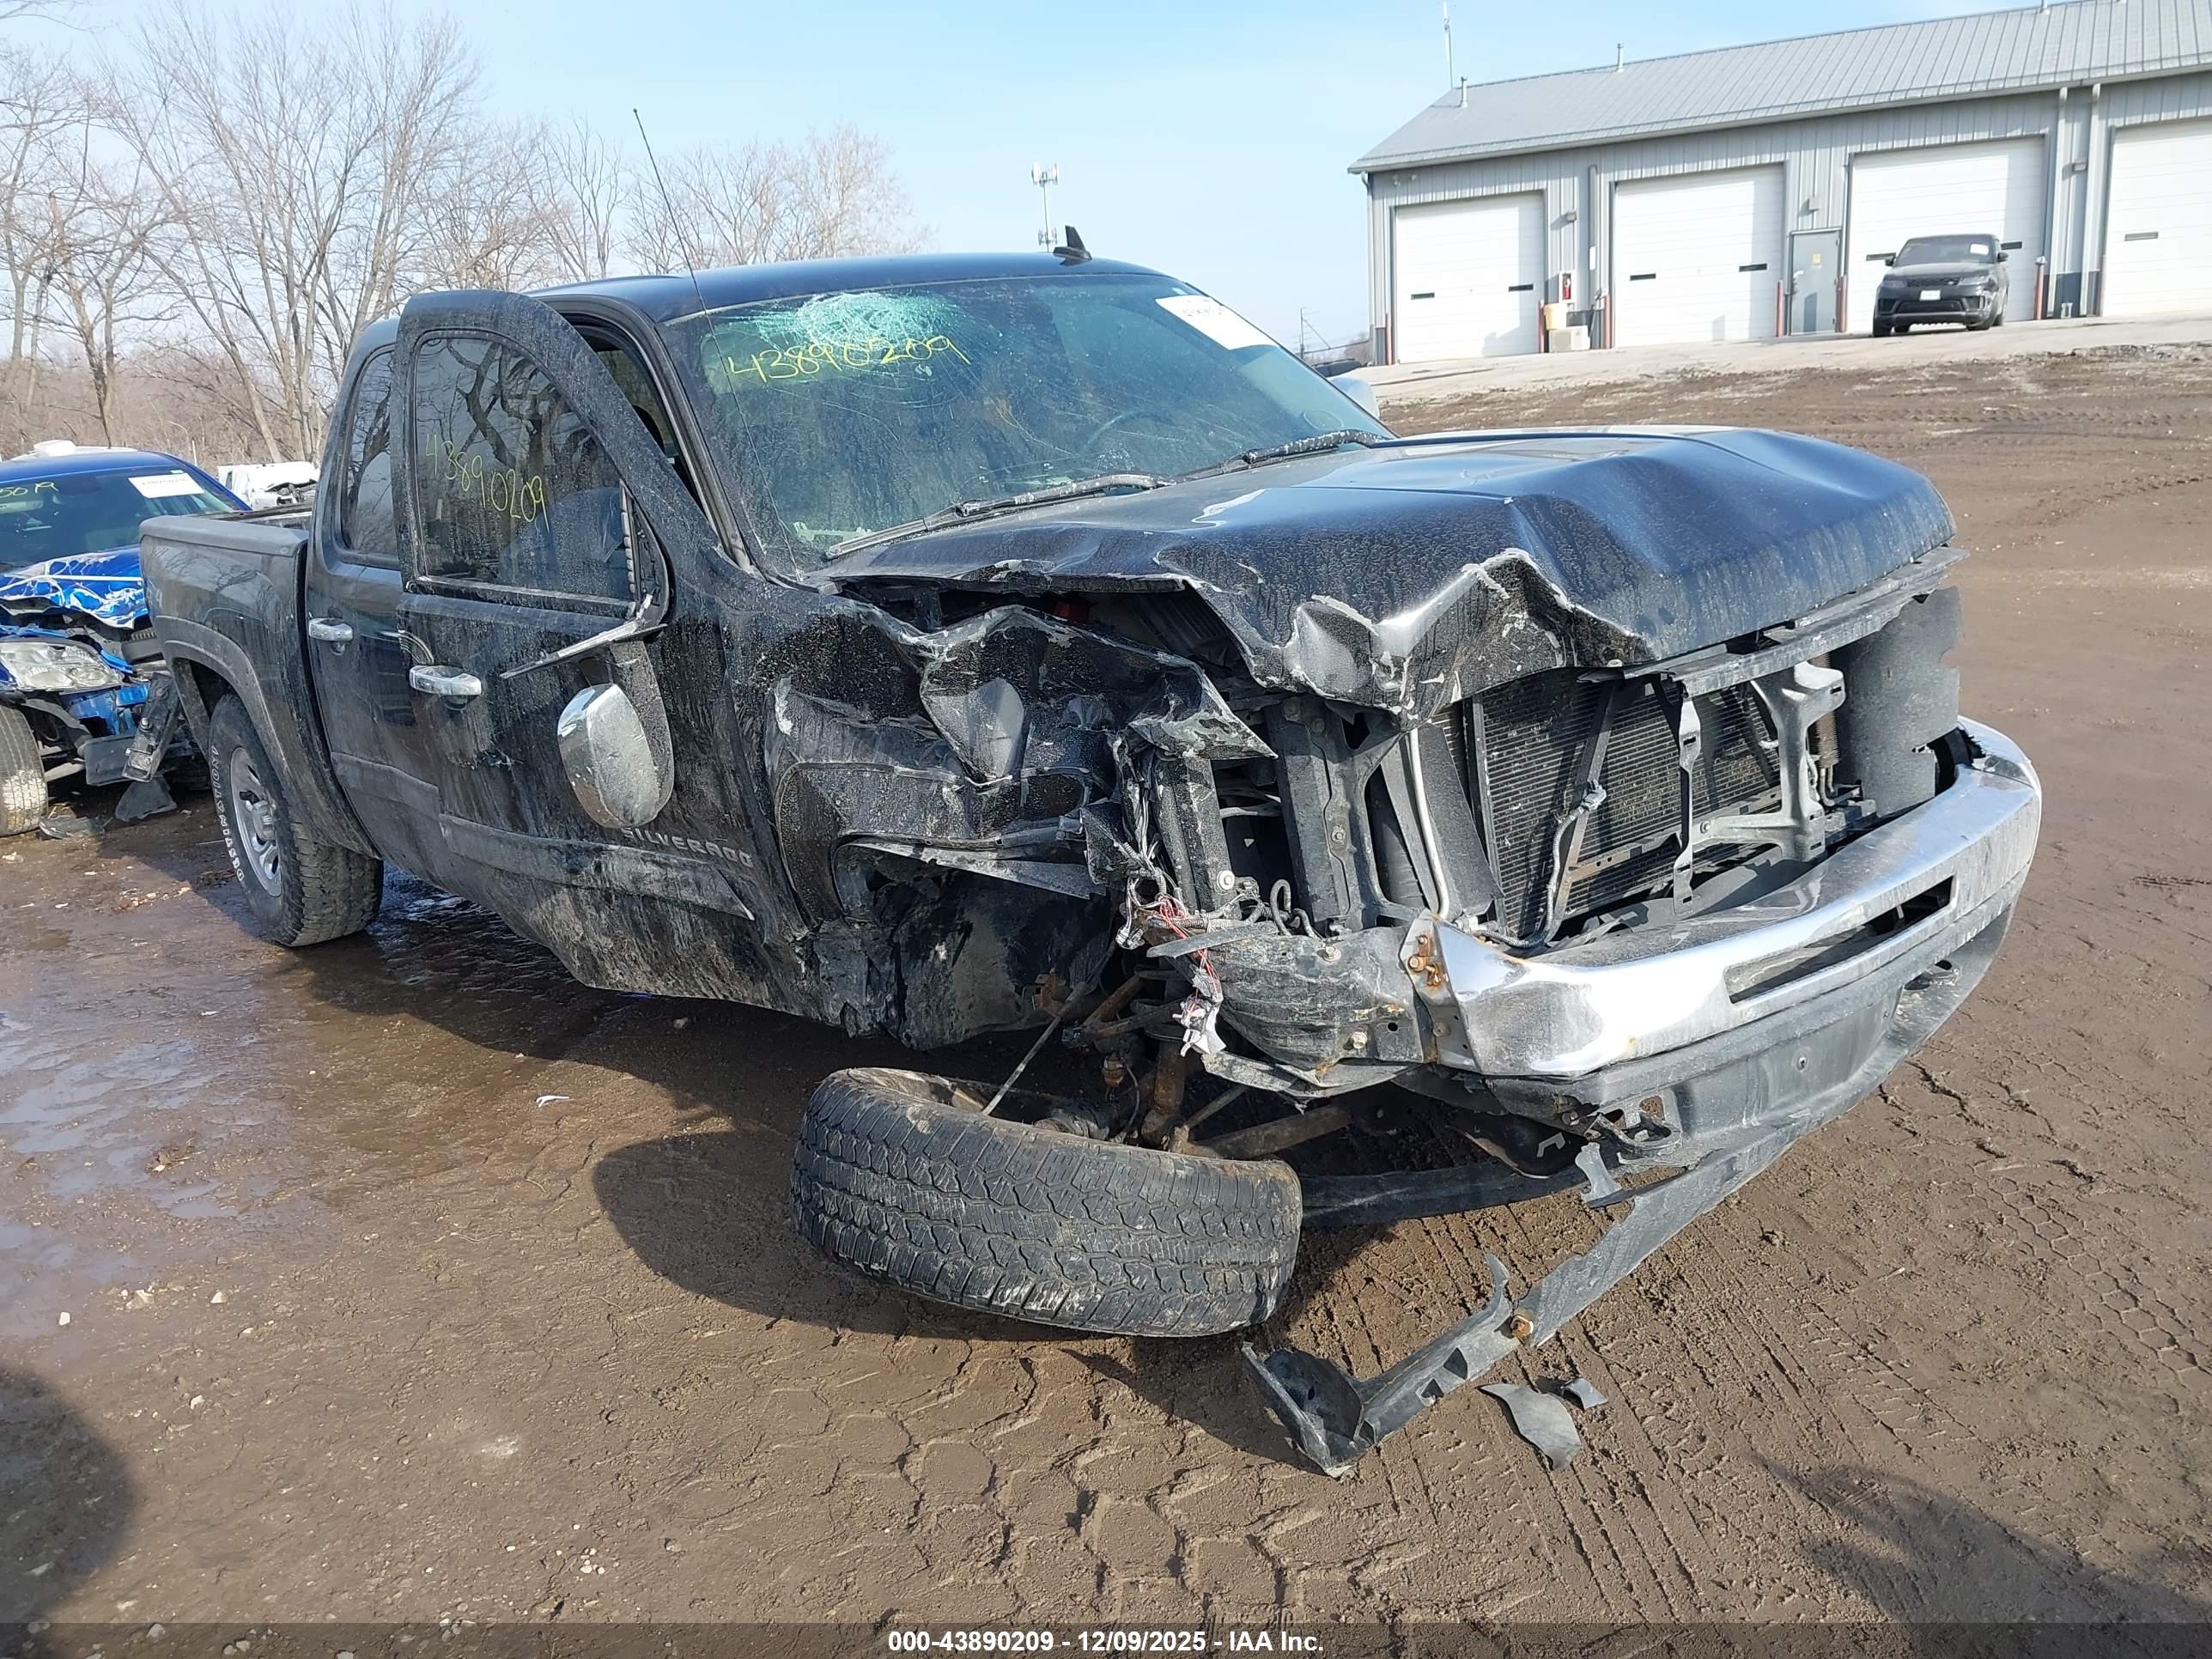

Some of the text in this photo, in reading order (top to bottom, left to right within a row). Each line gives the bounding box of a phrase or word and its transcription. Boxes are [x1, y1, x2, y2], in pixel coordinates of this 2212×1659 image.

[728, 335, 971, 383] 43890209
[425, 434, 550, 534] 43890209
[620, 827, 754, 868] SILVERADO
